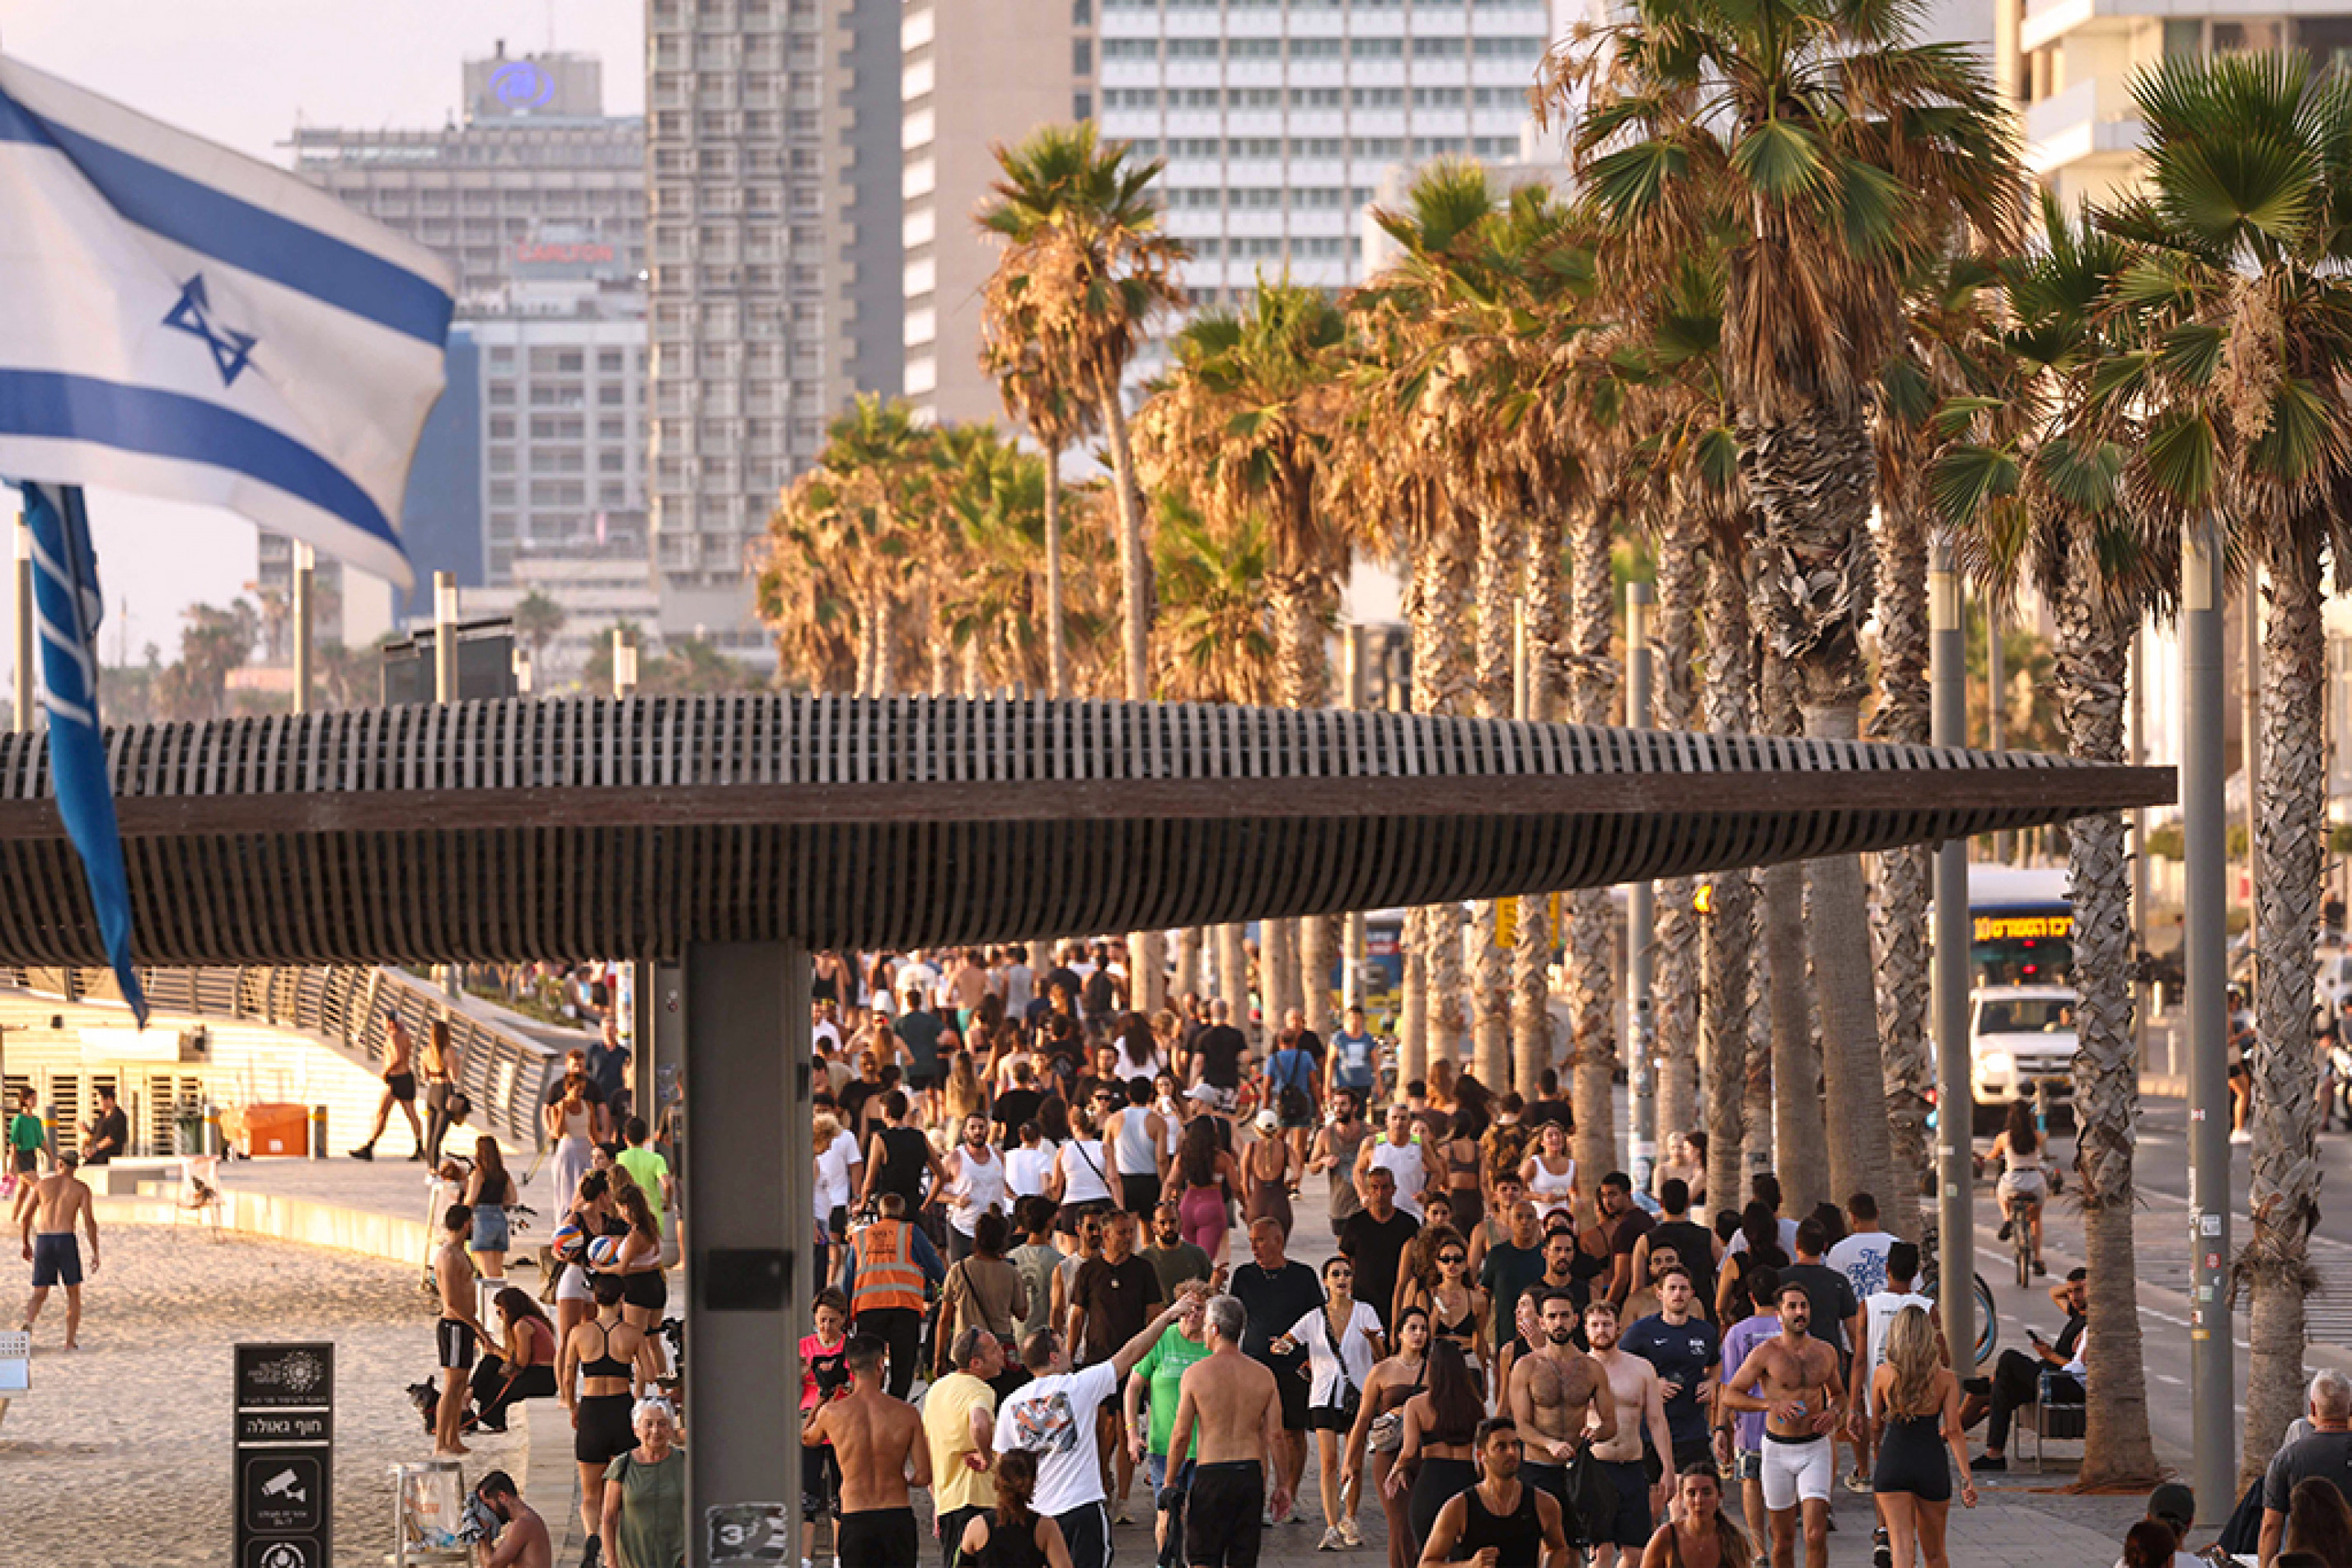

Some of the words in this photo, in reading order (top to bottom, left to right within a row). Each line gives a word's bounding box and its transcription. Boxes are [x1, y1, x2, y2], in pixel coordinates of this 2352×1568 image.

[518, 244, 613, 264] CARLTON
[246, 1418, 290, 1433] גאולה
[293, 1419, 321, 1435] חוף
